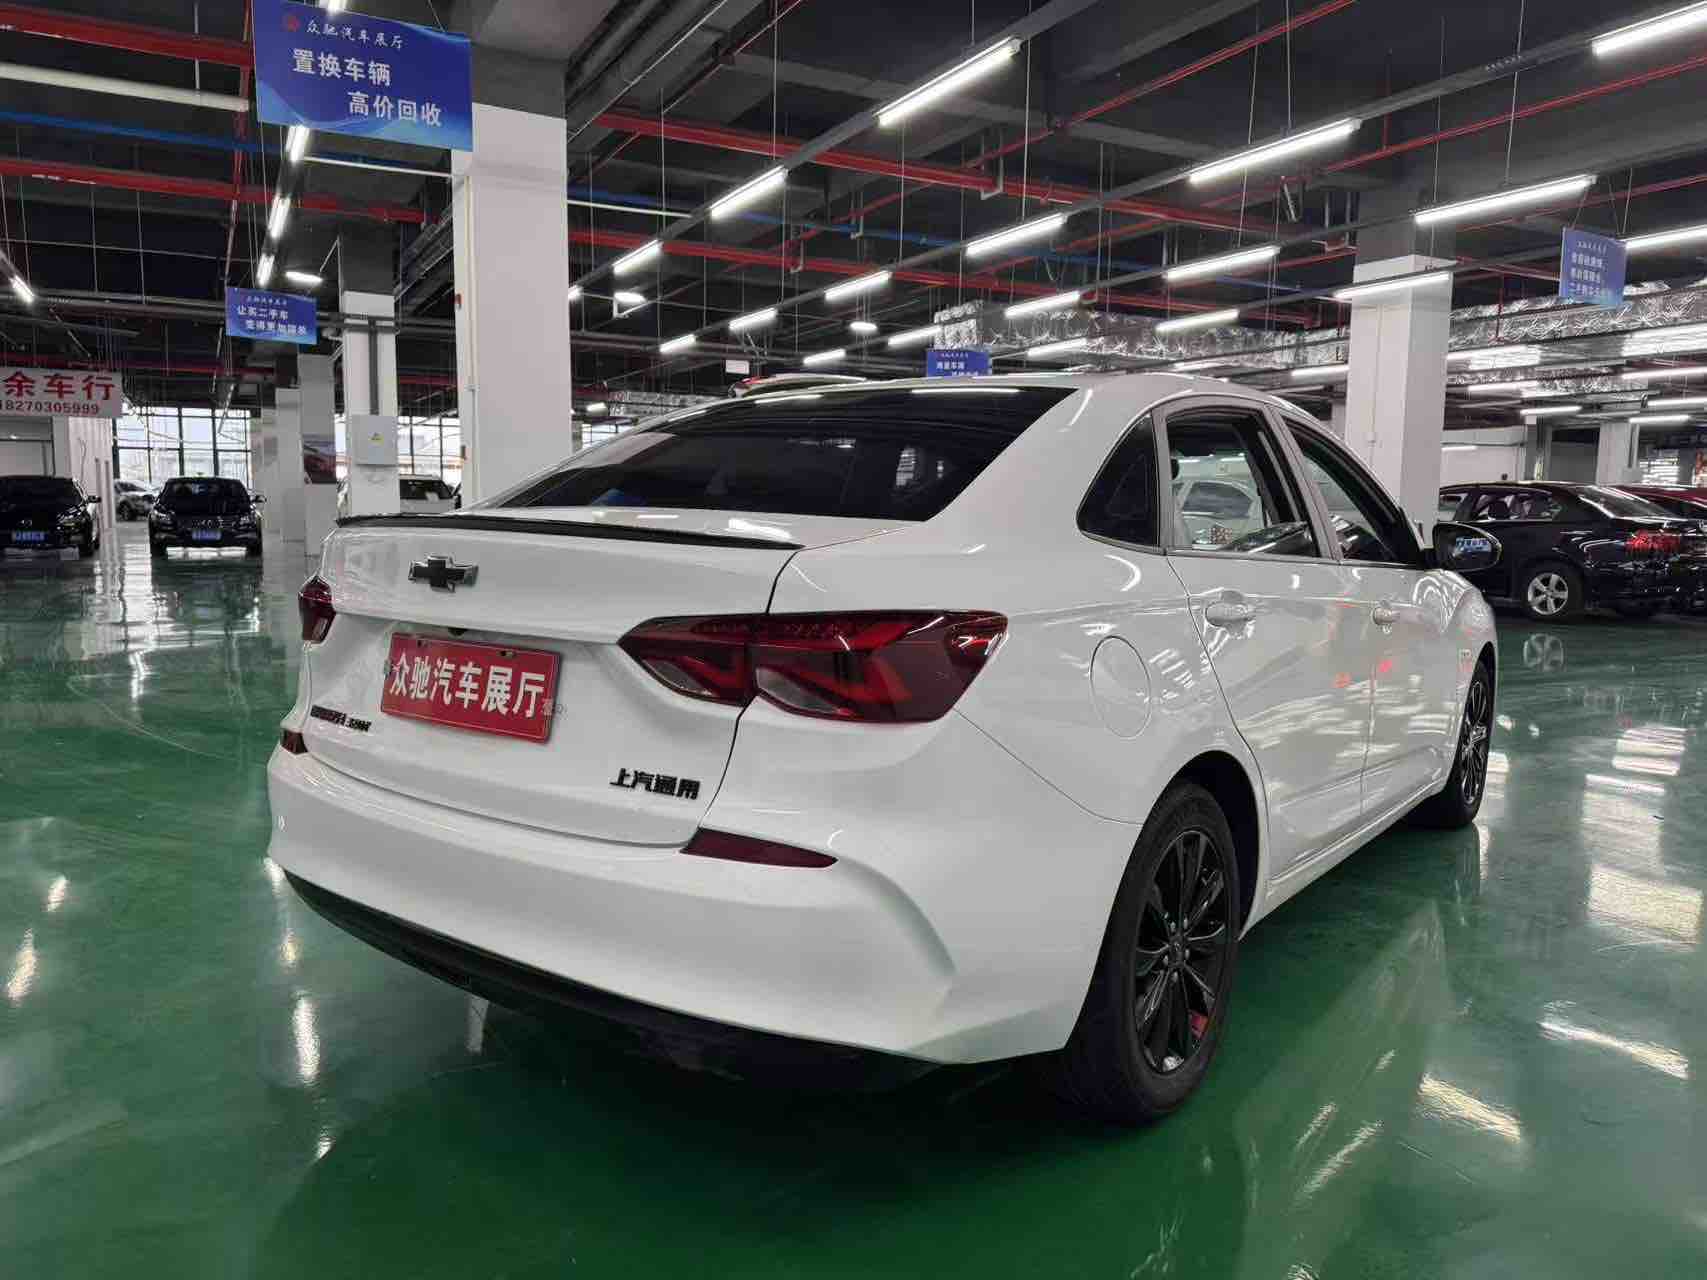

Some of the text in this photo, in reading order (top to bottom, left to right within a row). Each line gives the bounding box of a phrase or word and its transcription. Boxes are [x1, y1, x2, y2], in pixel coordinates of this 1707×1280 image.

[306, 19, 403, 49] 众驰汽车展厅
[292, 48, 391, 87] 置换车辆
[348, 91, 441, 127] 高价回收
[389, 649, 545, 718] 众驰汽车展厅
[609, 768, 700, 800] 上汽通用
